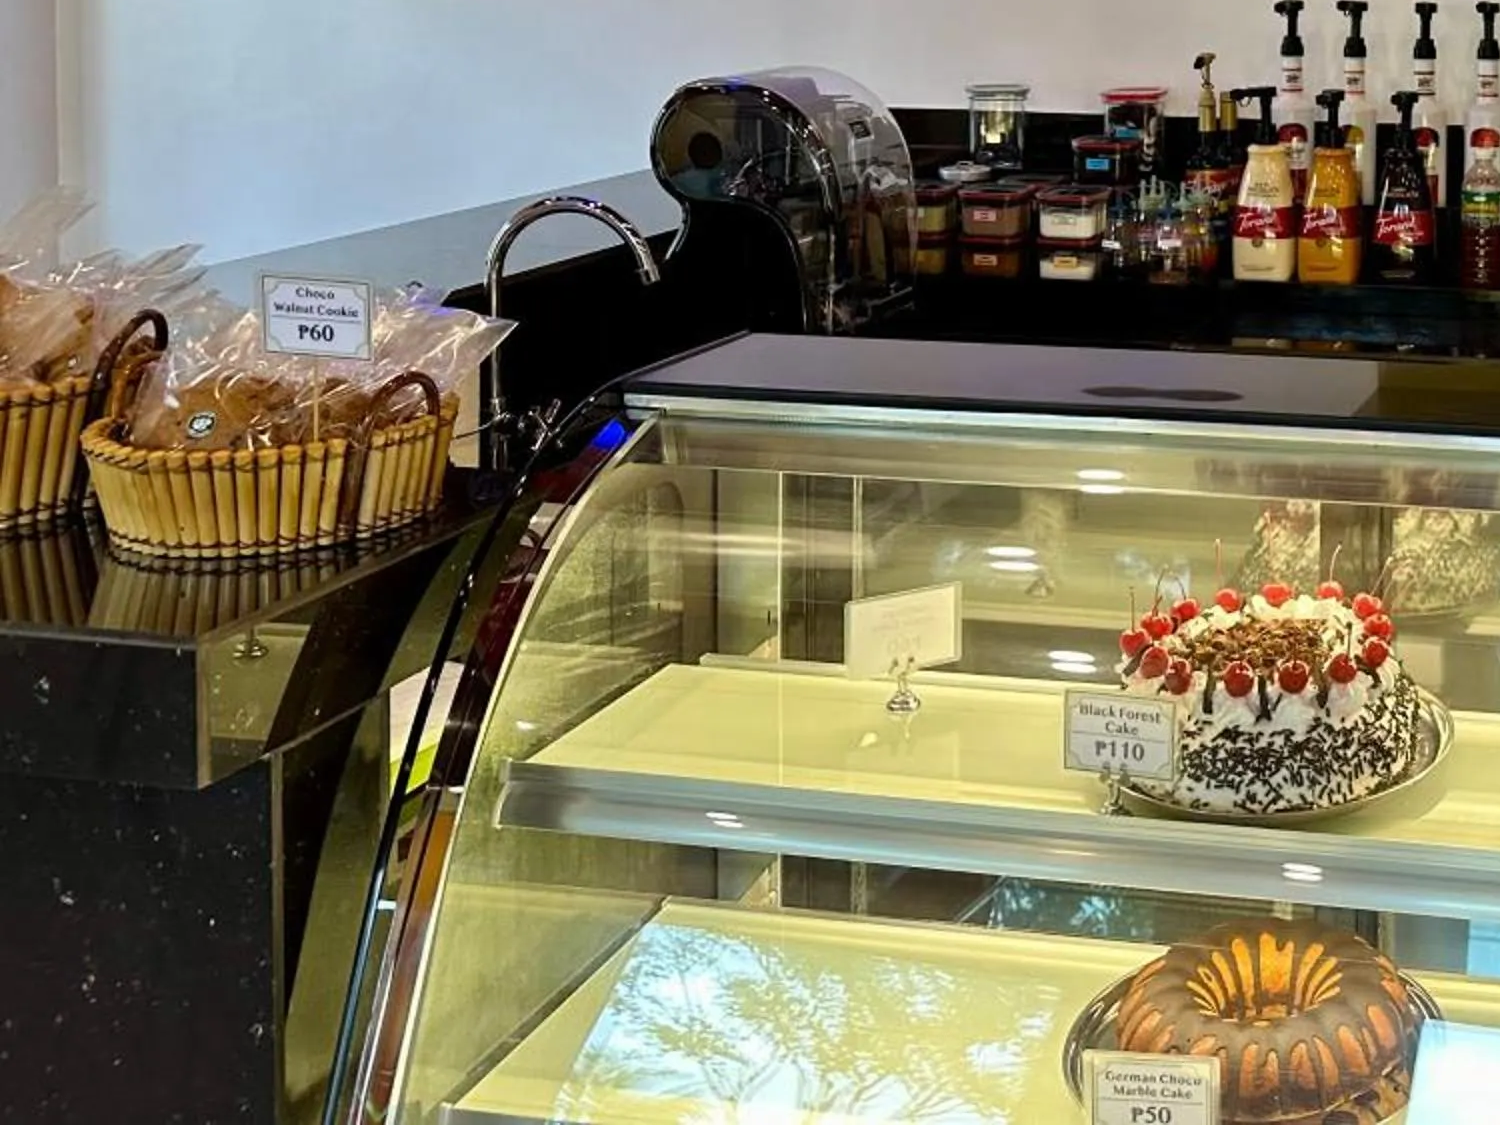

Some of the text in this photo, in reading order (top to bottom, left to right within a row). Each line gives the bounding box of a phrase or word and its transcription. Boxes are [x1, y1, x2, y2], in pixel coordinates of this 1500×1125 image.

[296, 288, 334, 299] Choco
[274, 302, 358, 317] Walnut Cookie
[1080, 704, 1159, 723] Black Forest
[1105, 720, 1138, 735] Cake
[1105, 1071, 1201, 1086] German Choco
[1113, 1085, 1192, 1099] Marble Cake
